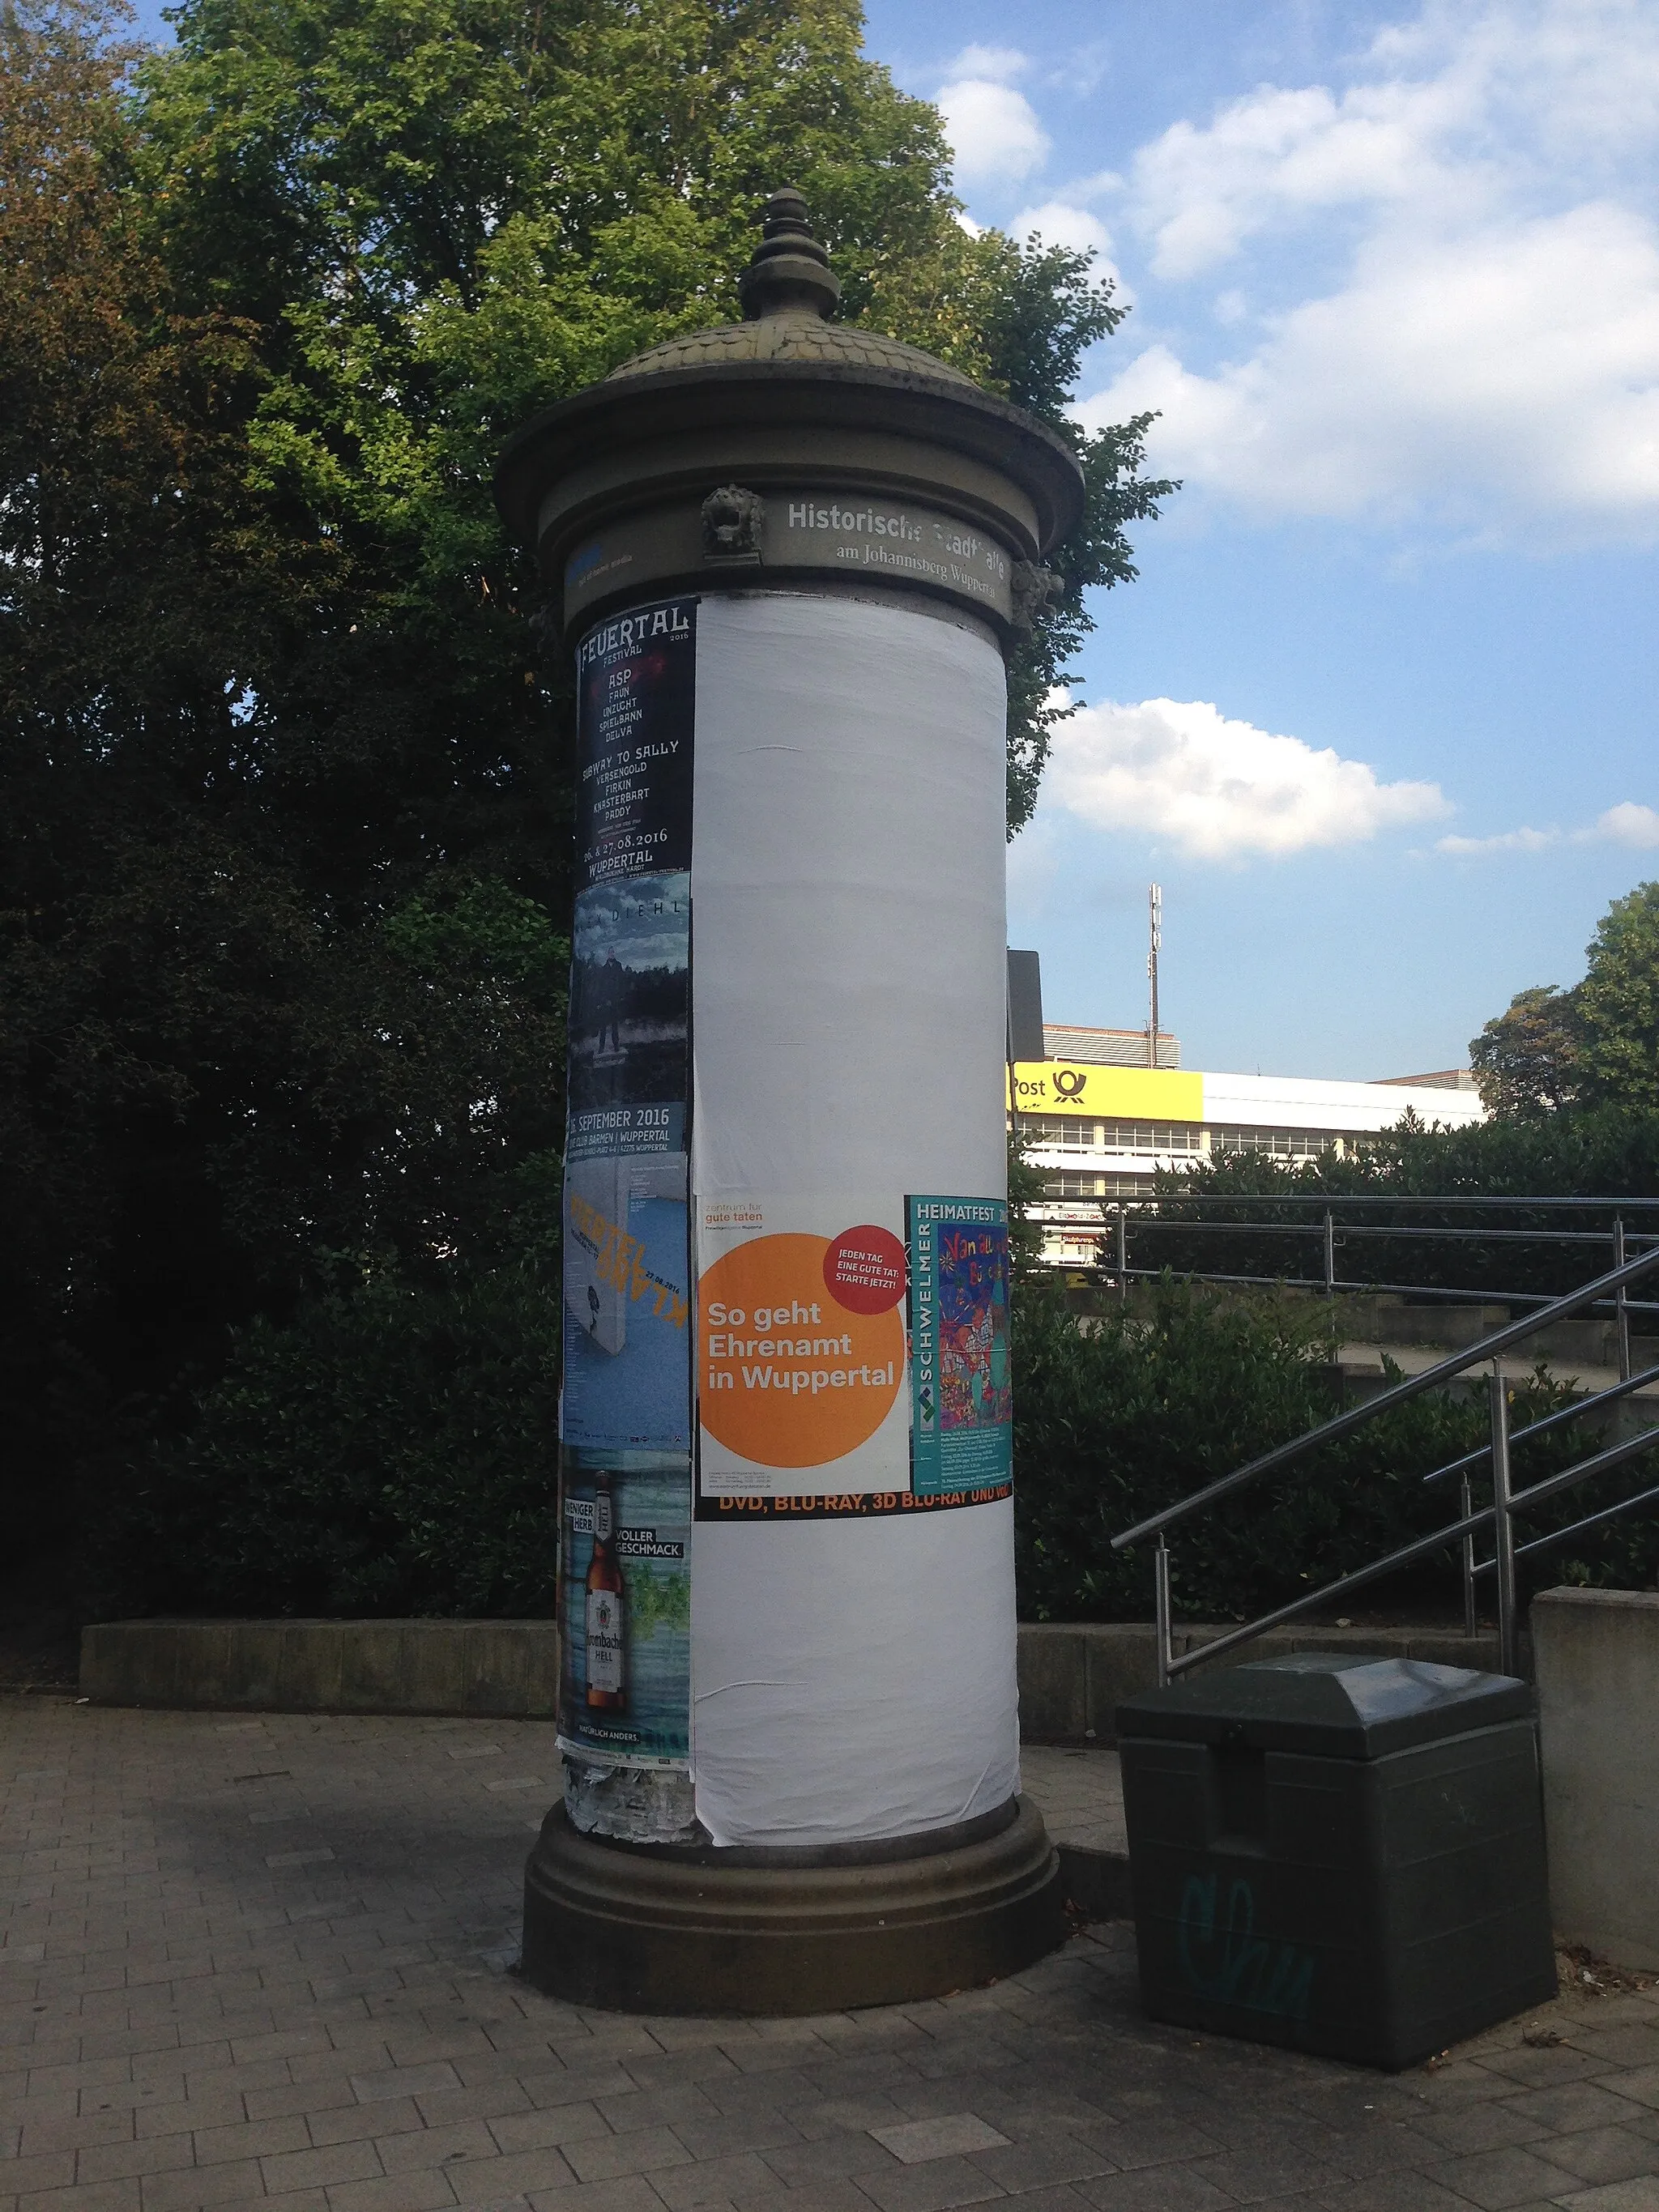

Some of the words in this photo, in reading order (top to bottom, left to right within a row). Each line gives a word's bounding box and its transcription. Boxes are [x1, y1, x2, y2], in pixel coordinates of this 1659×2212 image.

[933, 523, 1004, 581] adtalle
[836, 546, 859, 560] am
[863, 544, 948, 581] Johannisberg
[582, 607, 689, 673] FEUERTAL
[670, 632, 689, 641] 2016
[603, 645, 642, 668] FESTIVAL
[609, 668, 632, 688] ASP
[609, 687, 629, 703] FAUN
[603, 697, 638, 718] UNZUCHT
[599, 709, 642, 732] SPIELBANN
[606, 726, 633, 742] DELVA
[582, 757, 612, 782] SUBWAY
[617, 750, 630, 765] TO
[636, 739, 679, 760] SALLY
[596, 761, 647, 786] VERSENGOLD
[605, 778, 632, 796] FIRKIN
[593, 788, 650, 813] KNASTERBART
[605, 806, 631, 821] PADDY
[603, 829, 667, 856] 27.08.2016
[589, 850, 653, 879] WUPPERTAL
[579, 1110, 631, 1132] SEPTEMBER
[637, 1109, 669, 1126] 2016
[621, 1130, 670, 1143] WUPPERTAL
[637, 1144, 667, 1152] WUPPERTAL
[706, 1213, 730, 1224] gute
[733, 1212, 762, 1221] taten
[917, 1204, 995, 1222] HEIMATFEST
[838, 1249, 865, 1260] JEDEN
[867, 1253, 883, 1264] TAG
[838, 1260, 858, 1272] EINE
[859, 1264, 881, 1275] GUTE
[883, 1268, 899, 1278] TAT:
[836, 1272, 869, 1285] STARTE
[869, 1277, 896, 1289] JETZT!
[919, 1223, 932, 1381] SCHWELMER
[708, 1302, 746, 1326] So
[753, 1300, 821, 1332] geht
[709, 1333, 851, 1357] Ehrenamt
[709, 1365, 733, 1389] in
[741, 1362, 894, 1395] Wuppertal
[719, 1496, 768, 1513] DVD,
[774, 1494, 867, 1512] BLU-RAY,
[872, 1492, 896, 1509] 3D
[902, 1490, 966, 1508] BLU-RAY
[972, 1485, 994, 1502] UND
[574, 1516, 593, 1531] HERB
[616, 1530, 654, 1542] VOLLER
[616, 1542, 681, 1556] GESCHMACK.
[595, 1651, 613, 1662] HELL
[579, 1724, 608, 1737] NATÜRLICH
[609, 1731, 639, 1742] ANDERS.
